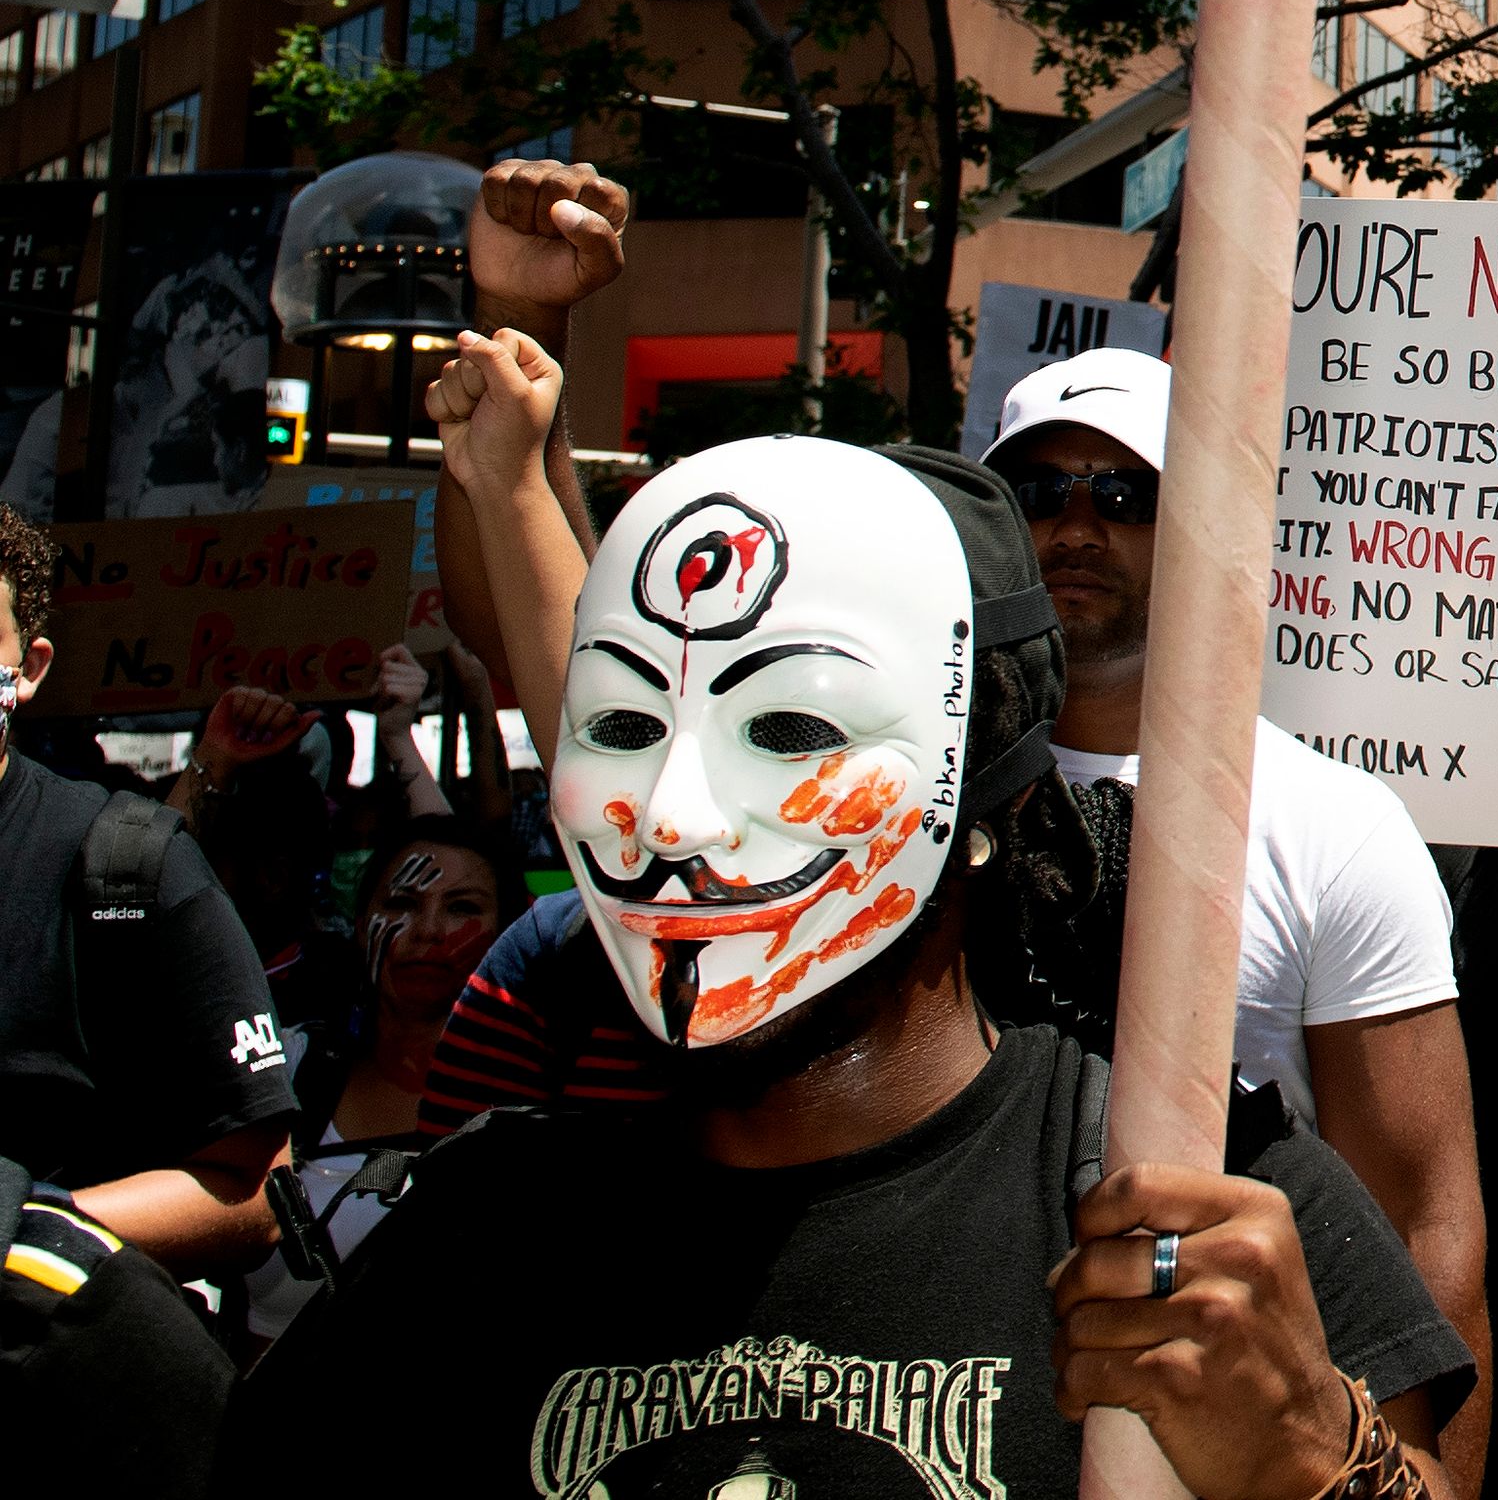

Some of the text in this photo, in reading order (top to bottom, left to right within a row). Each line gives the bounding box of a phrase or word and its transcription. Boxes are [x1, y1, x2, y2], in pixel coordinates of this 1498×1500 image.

[1292, 218, 1438, 318] OU'RE
[1321, 338, 1371, 382] BE
[1394, 345, 1449, 385] SO
[1312, 469, 1367, 506] YOU
[1375, 476, 1465, 520] CAN'T
[53, 541, 129, 587] No
[160, 522, 378, 590] Justice
[1273, 519, 1333, 559] ITY.
[1349, 518, 1496, 581] WRONG
[1351, 579, 1412, 621] NO
[102, 611, 374, 693] No Peace
[1276, 622, 1373, 675] DOES
[1394, 649, 1448, 683] OR
[1294, 733, 1467, 782] ALCOLM X
[91, 907, 145, 920] adidas
